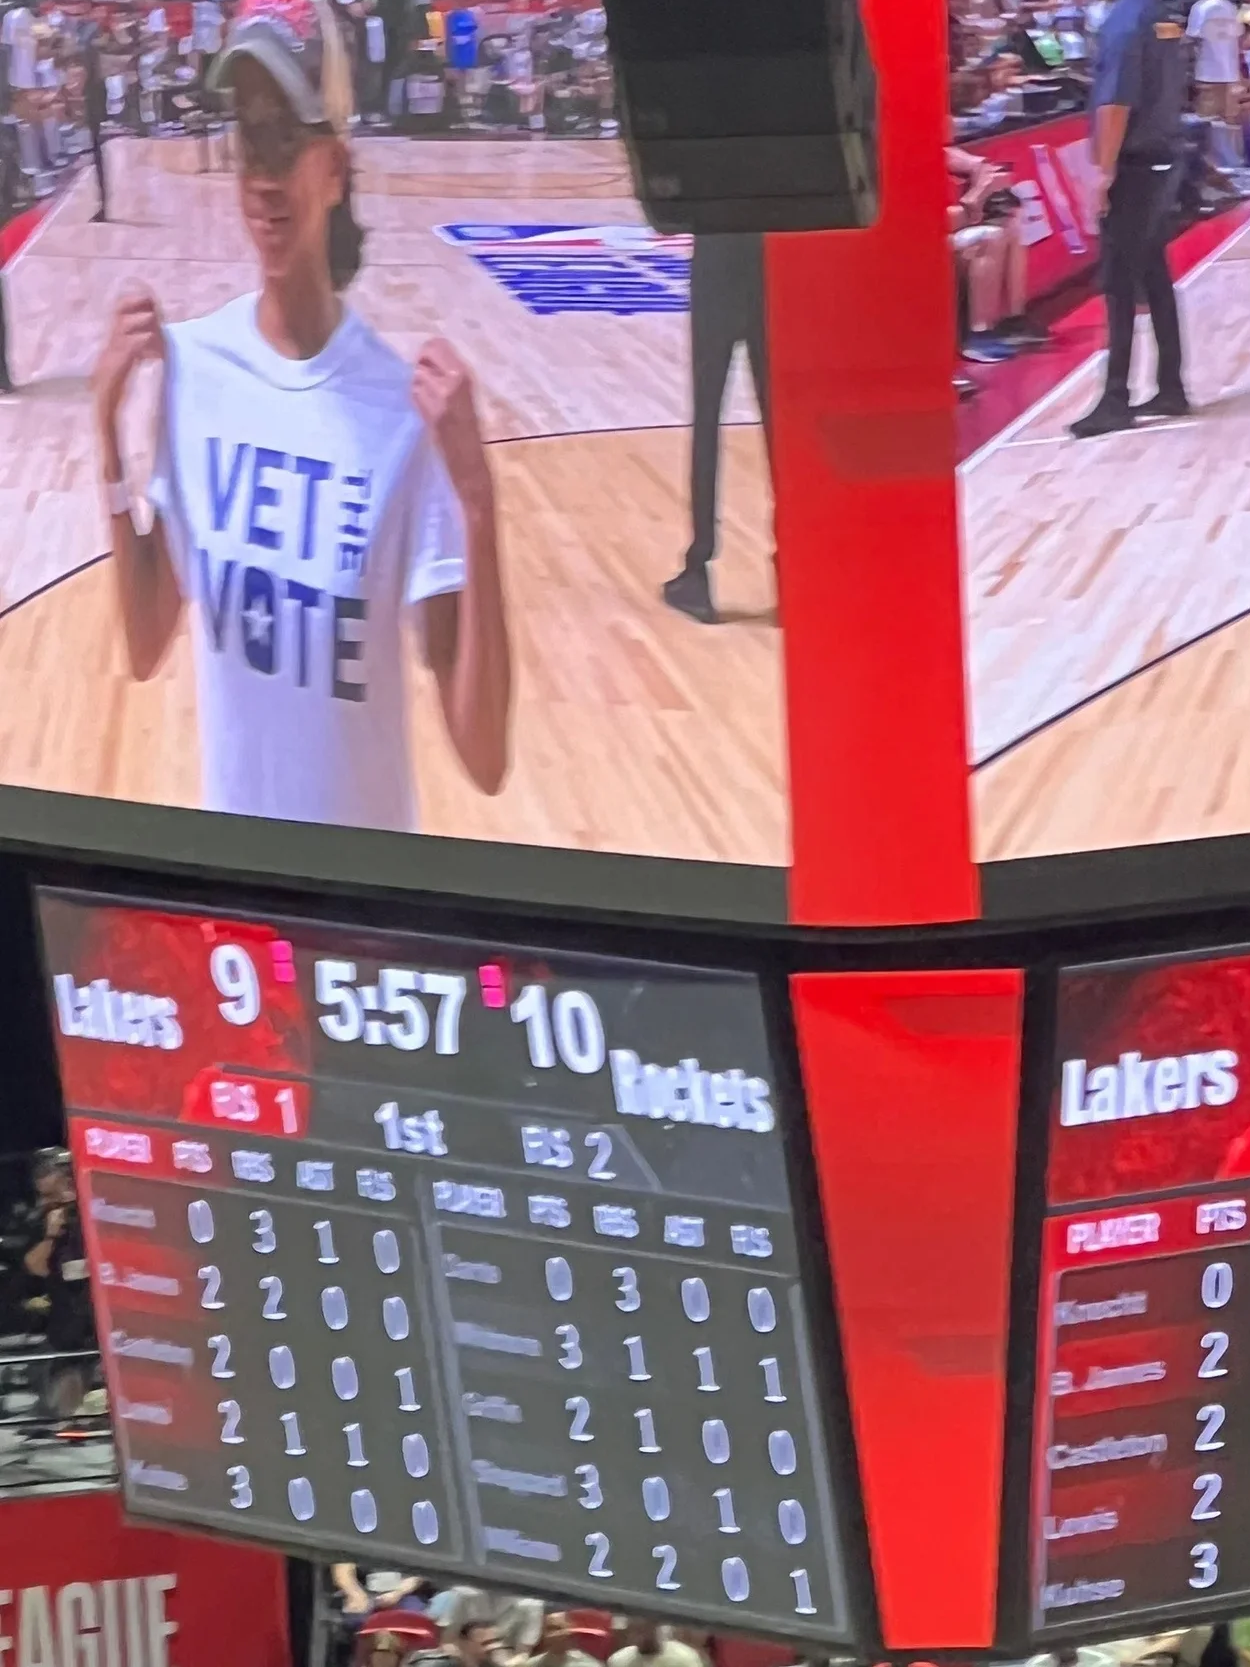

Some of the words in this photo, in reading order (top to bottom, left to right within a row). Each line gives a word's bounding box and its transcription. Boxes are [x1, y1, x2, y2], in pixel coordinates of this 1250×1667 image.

[204, 436, 335, 560] VET
[197, 547, 369, 703] VOTE
[210, 943, 261, 1026] 9
[314, 959, 467, 1055] 5:57
[510, 984, 606, 1074] 10
[275, 1088, 298, 1134] 1
[1060, 1049, 1239, 1127] Lakers
[373, 1101, 449, 1157] 1st
[584, 1131, 618, 1181] 2
[187, 1199, 215, 1244] 0
[248, 1209, 277, 1254] 3
[312, 1220, 340, 1264] 1
[372, 1229, 401, 1274] 0
[197, 1264, 226, 1310] 2
[258, 1275, 288, 1320] 2
[321, 1285, 349, 1331] 0
[382, 1296, 410, 1341] 0
[545, 1256, 573, 1301] 0
[611, 1266, 641, 1312] 3
[681, 1276, 710, 1323] 0
[747, 1286, 777, 1333] 0
[1201, 1262, 1233, 1309] 0
[207, 1334, 236, 1379] 2
[268, 1345, 296, 1390] 0
[331, 1355, 359, 1401] 0
[393, 1366, 422, 1412] 1
[554, 1323, 584, 1370] 3
[622, 1335, 653, 1381] 1
[692, 1346, 721, 1392] 1
[758, 1357, 788, 1403] 1
[1197, 1331, 1229, 1378] 2
[217, 1399, 245, 1444] 2
[279, 1411, 307, 1456] 1
[341, 1422, 370, 1467] 1
[402, 1432, 430, 1478] 0
[564, 1395, 595, 1442] 2
[633, 1408, 663, 1453] 1
[701, 1418, 731, 1464] 0
[768, 1429, 797, 1476] 0
[1194, 1404, 1226, 1451] 2
[226, 1464, 253, 1509] 3
[287, 1476, 315, 1521] 0
[350, 1488, 378, 1533] 0
[411, 1500, 439, 1545] 0
[574, 1463, 604, 1510] 3
[641, 1475, 671, 1522] 0
[711, 1487, 742, 1534] 1
[777, 1498, 807, 1545] 0
[1190, 1473, 1223, 1520] 2
[584, 1531, 614, 1578] 2
[651, 1544, 682, 1590] 2
[721, 1556, 750, 1602] 0
[788, 1568, 818, 1615] 1
[1188, 1541, 1219, 1589] 3
